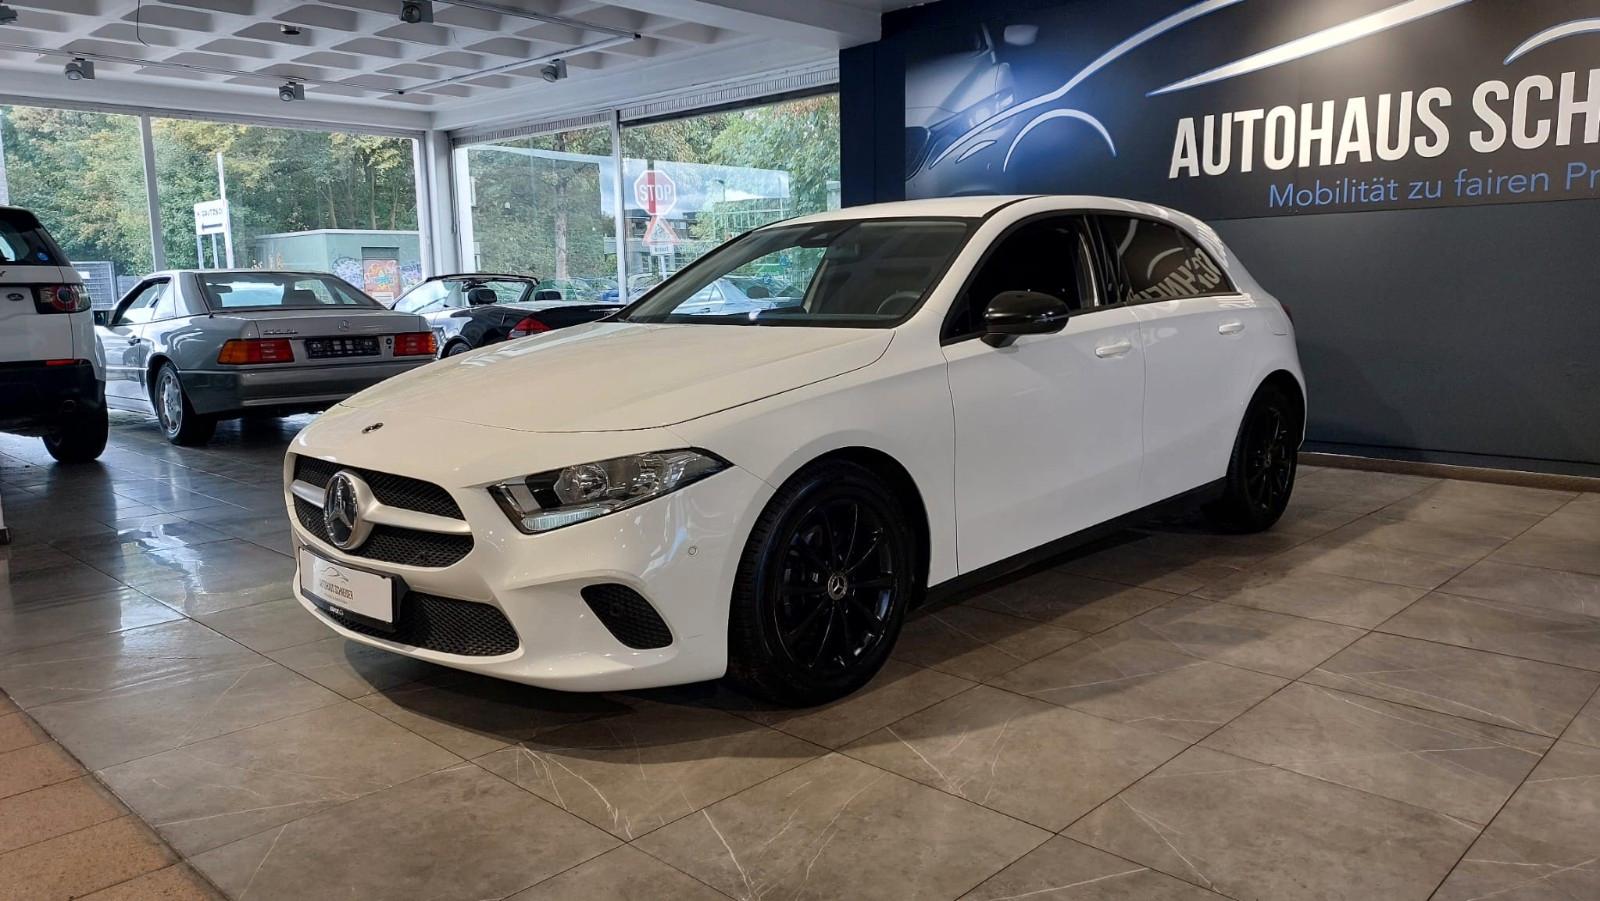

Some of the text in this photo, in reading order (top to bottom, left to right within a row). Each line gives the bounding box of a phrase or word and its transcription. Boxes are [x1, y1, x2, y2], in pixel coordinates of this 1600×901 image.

[1168, 68, 1600, 179] AUTOHAUS SCH
[639, 184, 672, 201] STOP
[1268, 176, 1399, 208] Mobilität
[1407, 179, 1443, 200] zu
[1453, 168, 1550, 197] fairen
